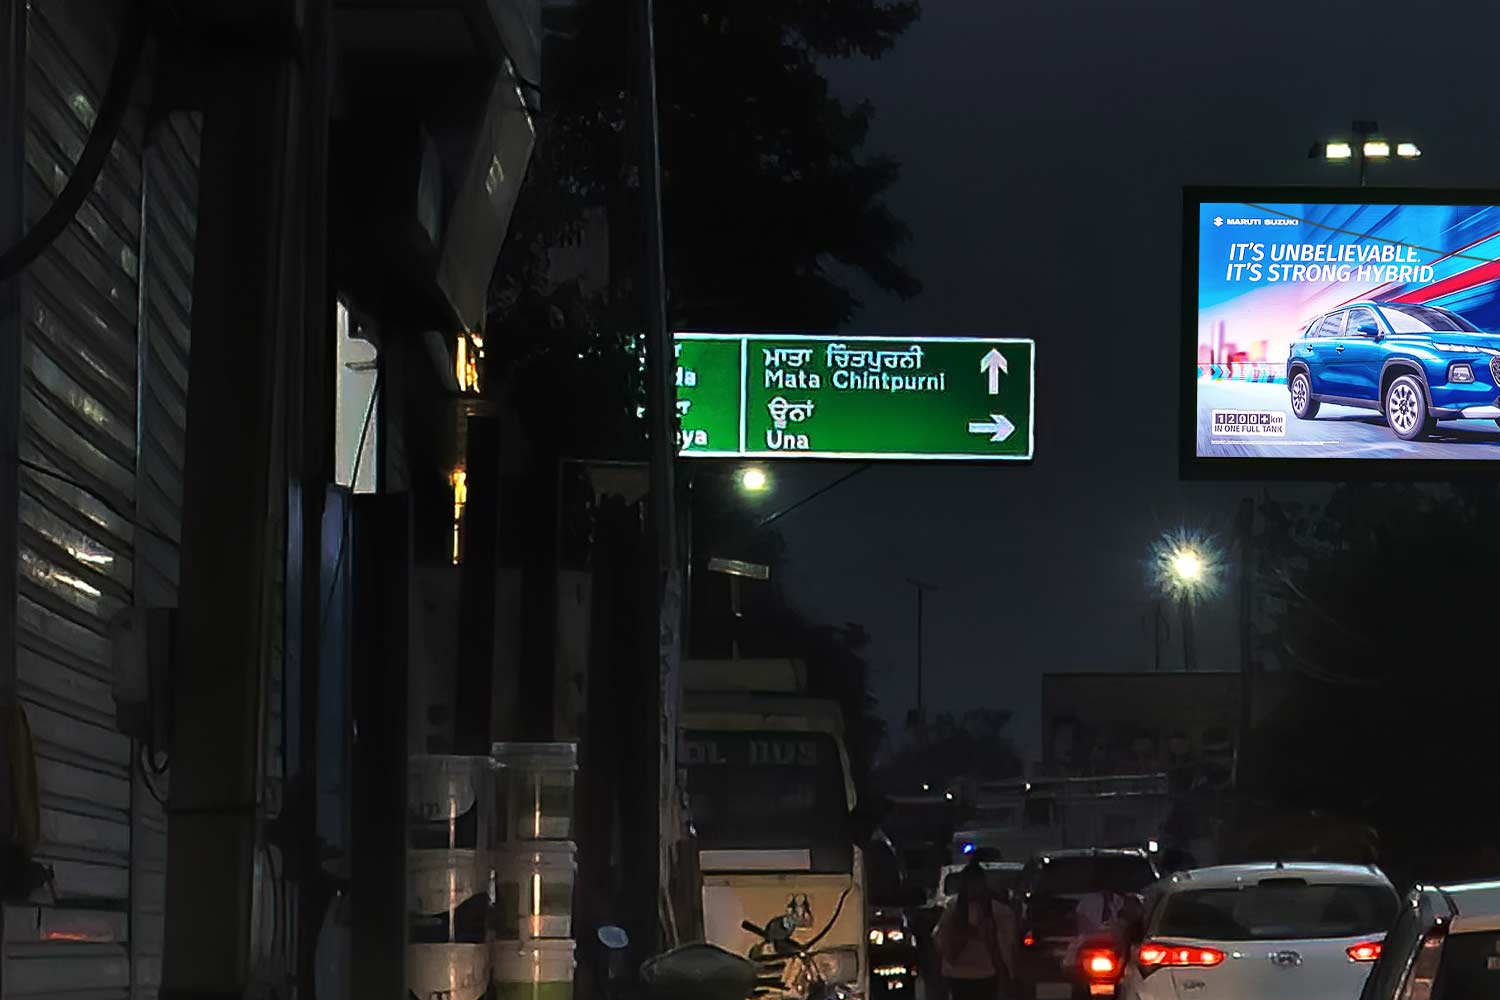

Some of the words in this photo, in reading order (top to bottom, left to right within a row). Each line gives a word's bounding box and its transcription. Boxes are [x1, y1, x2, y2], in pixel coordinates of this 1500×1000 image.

[1226, 218, 1261, 226] MARUTI
[1264, 218, 1299, 226] SUZUKI
[1229, 243, 1265, 262] IT'S
[1270, 243, 1421, 263] UNBELIEVABLE.
[1226, 263, 1263, 282] IT'S
[1267, 263, 1351, 283] STRONG
[1356, 264, 1436, 283] HYBRID.
[762, 348, 813, 367] ਮਾਤਾ
[764, 369, 821, 388] Mata
[832, 370, 945, 393] Chintpurni
[1214, 425, 1223, 433] IN
[1224, 425, 1240, 433] ONE
[1241, 425, 1260, 433] FULL
[1262, 425, 1283, 433] TANK
[766, 429, 809, 450] Una
